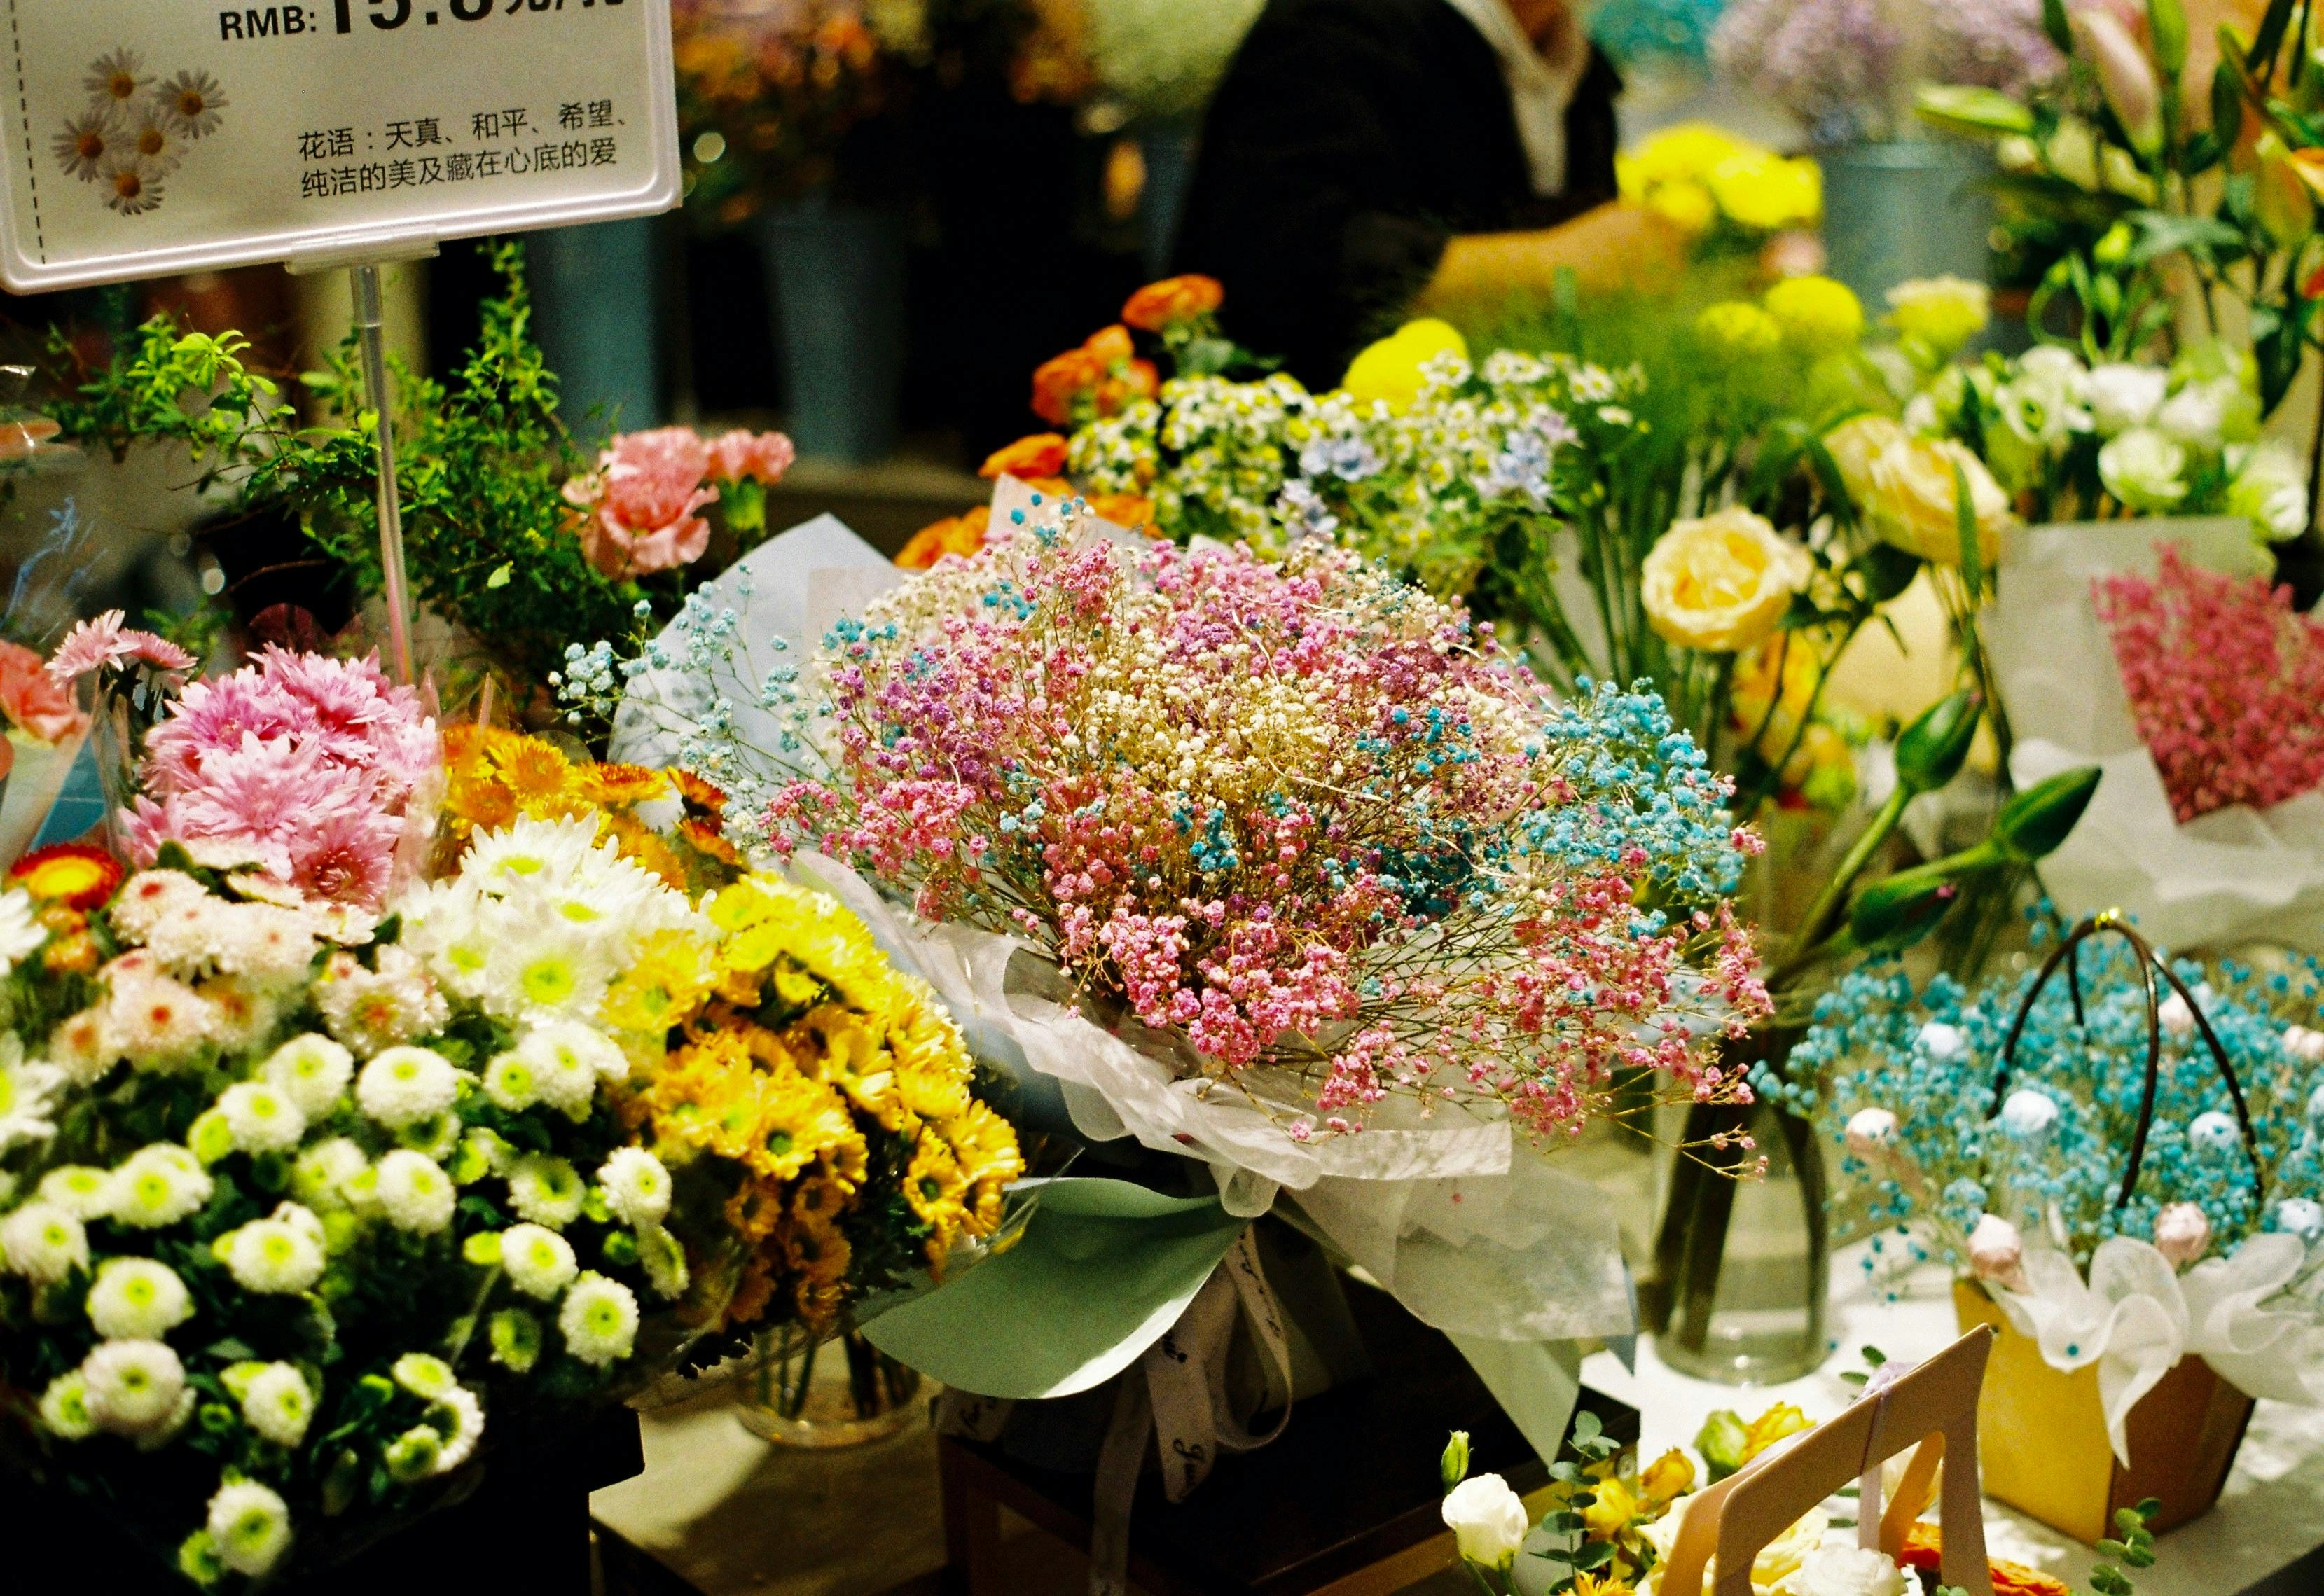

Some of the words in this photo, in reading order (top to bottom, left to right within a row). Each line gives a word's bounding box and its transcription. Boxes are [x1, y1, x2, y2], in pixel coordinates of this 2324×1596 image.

[219, 6, 317, 40] RMB:
[302, 137, 618, 198] 纯洁的美及藏在心底的爱
